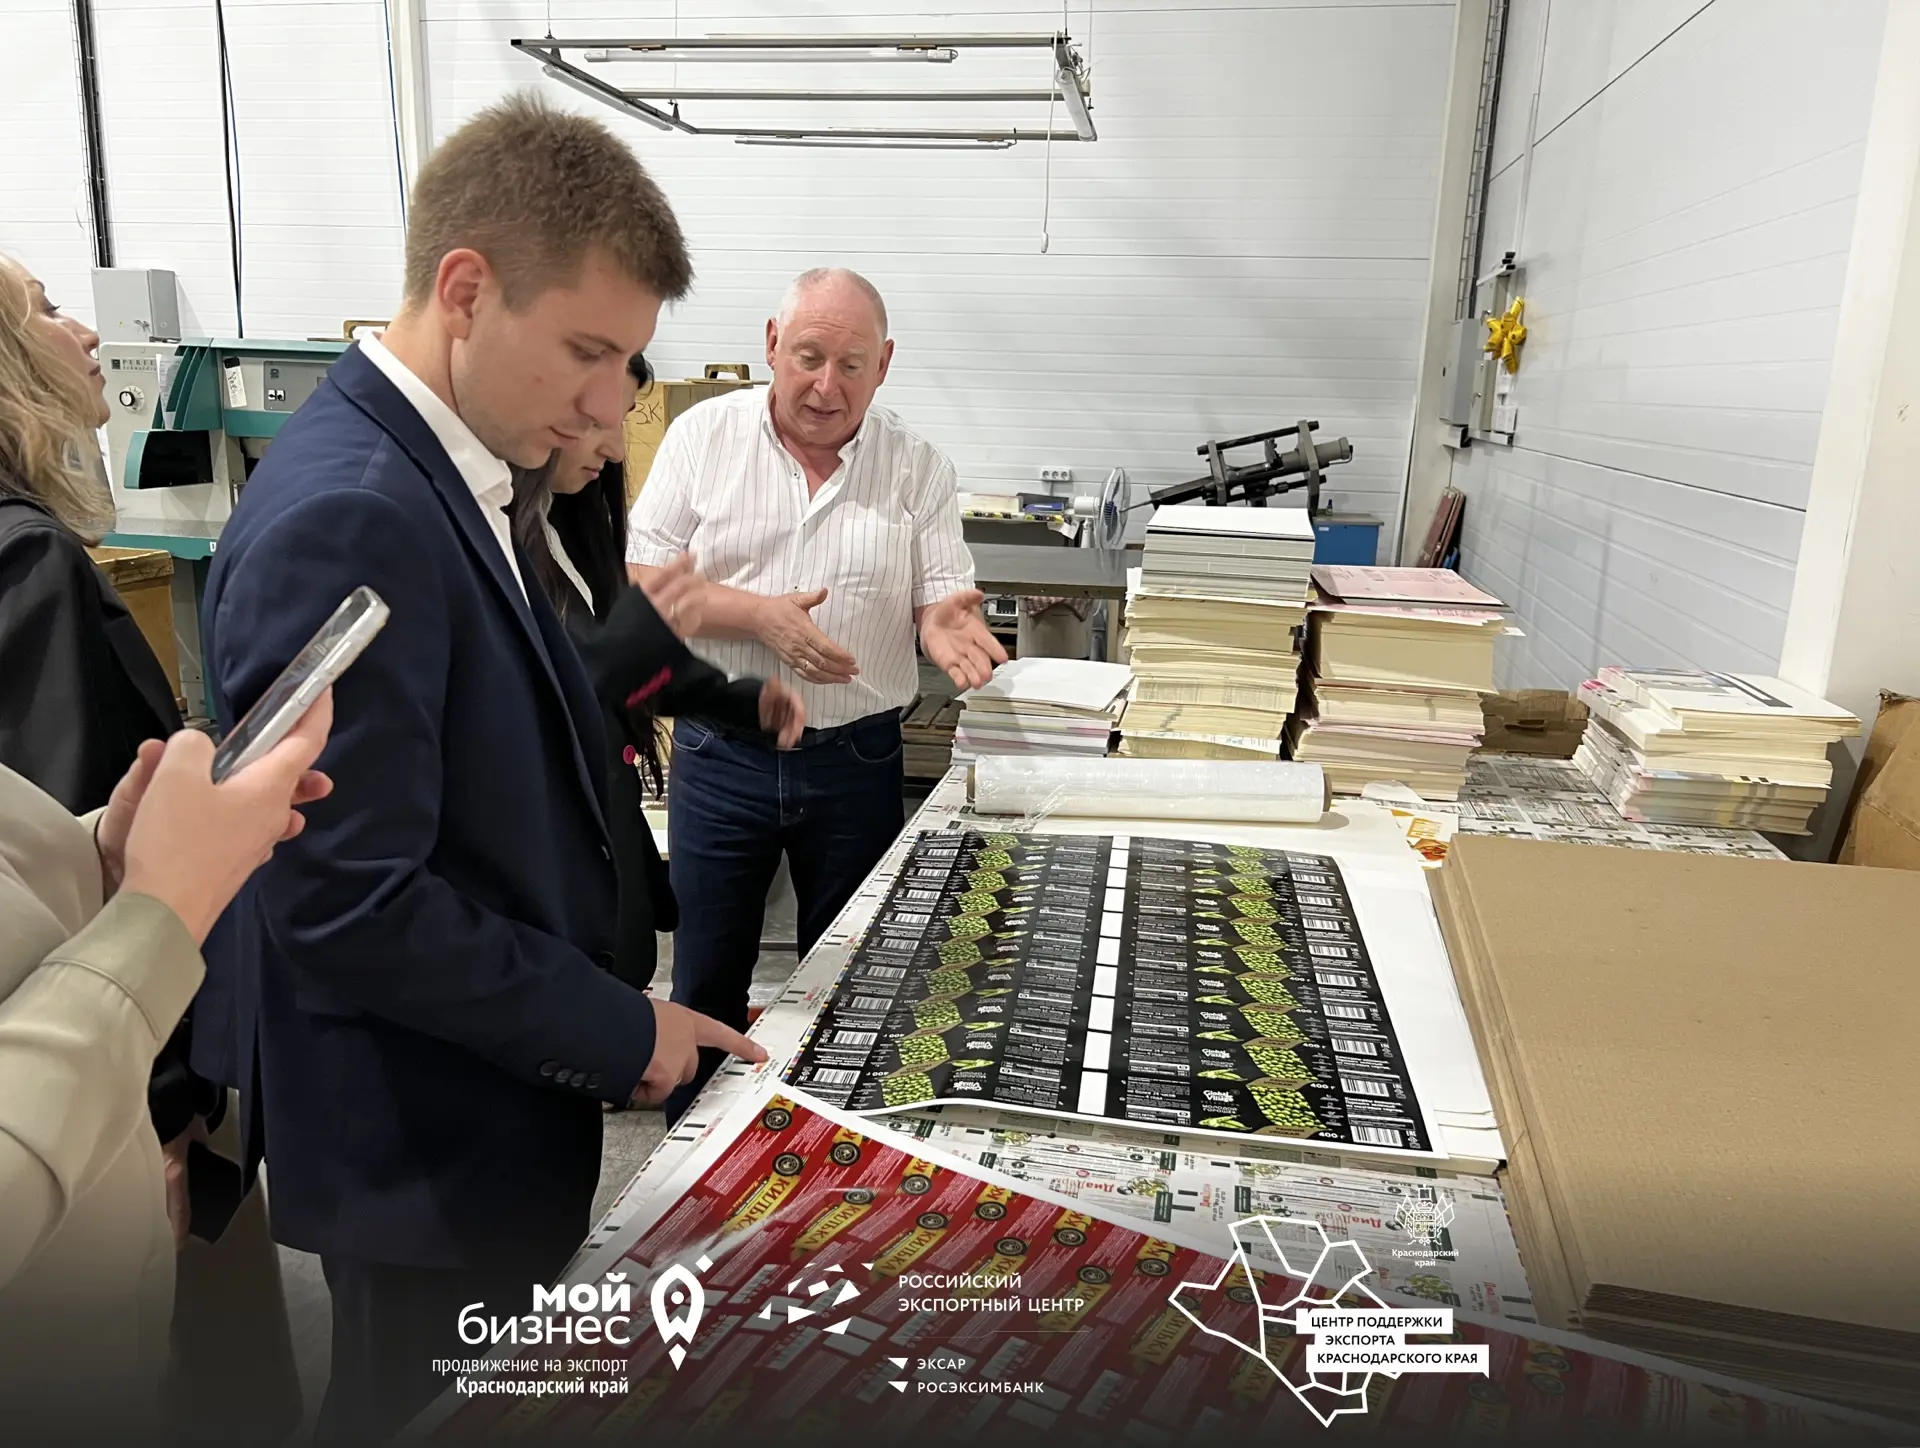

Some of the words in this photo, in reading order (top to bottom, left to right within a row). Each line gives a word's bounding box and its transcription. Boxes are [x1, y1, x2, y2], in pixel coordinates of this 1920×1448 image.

[1318, 1131, 1339, 1139] 400
[804, 1204, 864, 1245] КИЛЬКА
[881, 1230, 935, 1271] КИЛЬКА
